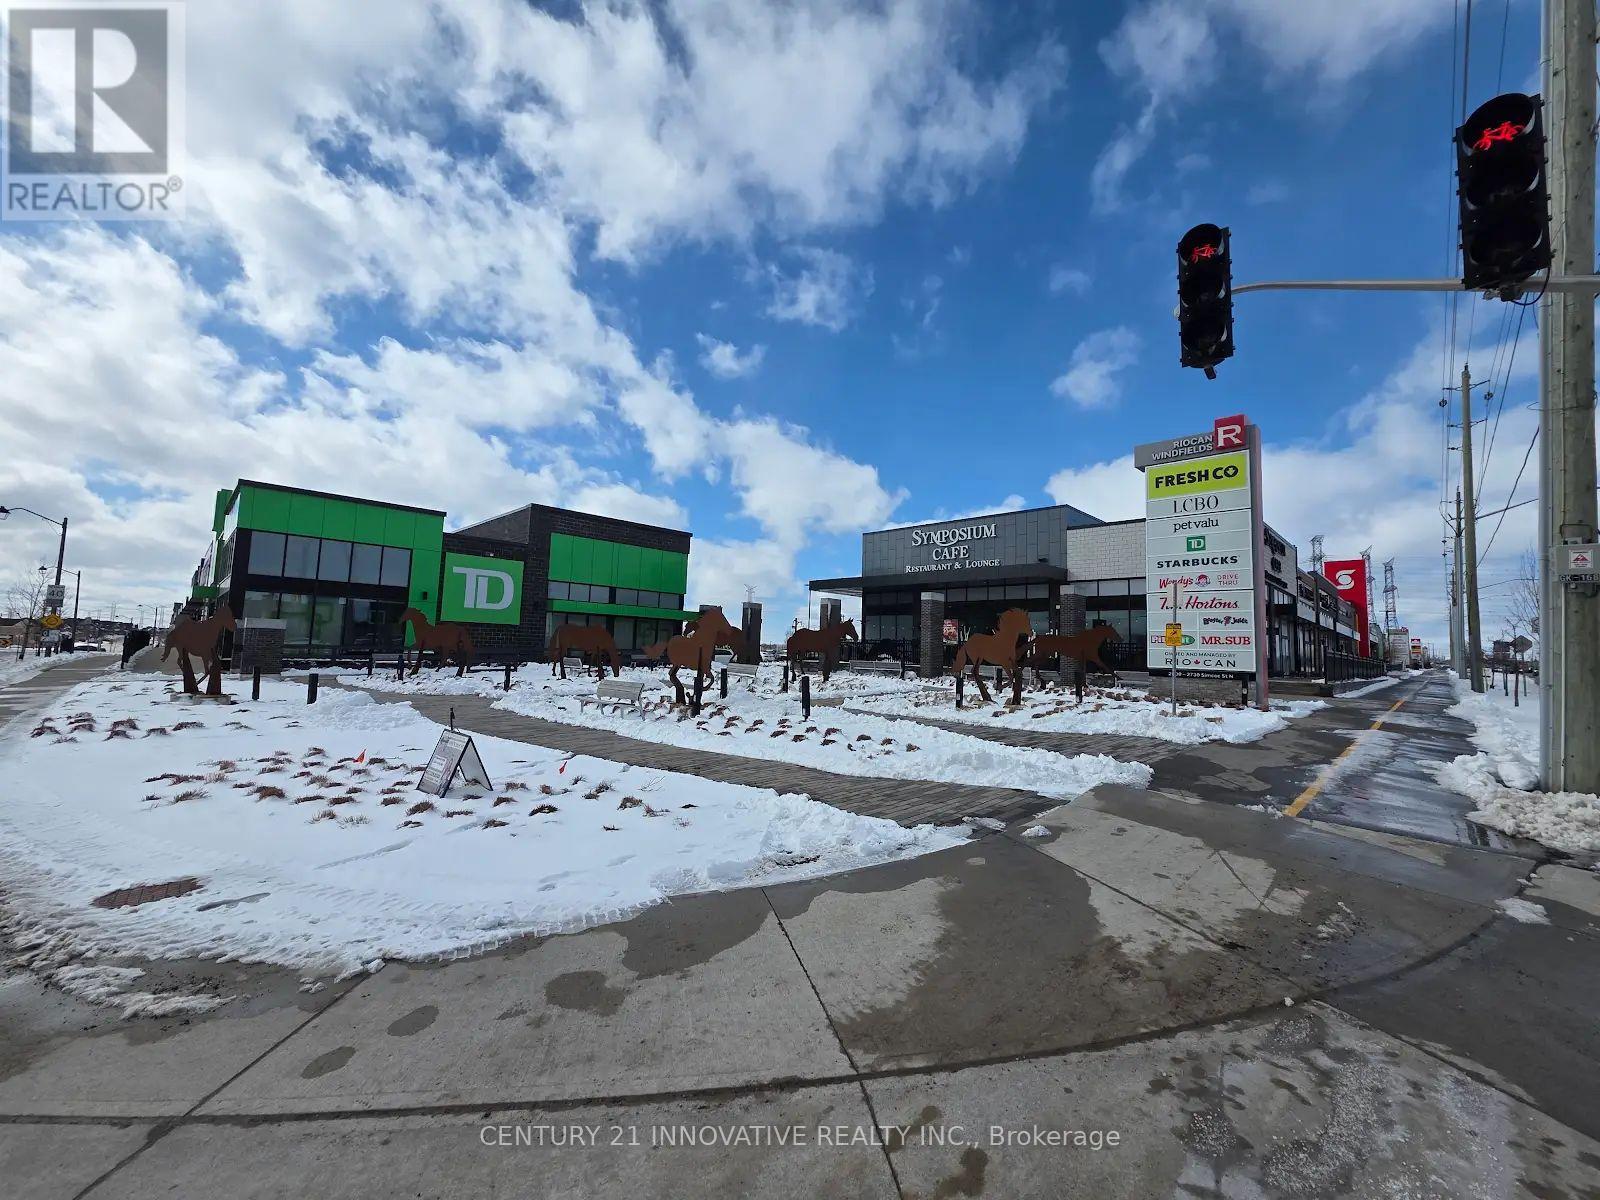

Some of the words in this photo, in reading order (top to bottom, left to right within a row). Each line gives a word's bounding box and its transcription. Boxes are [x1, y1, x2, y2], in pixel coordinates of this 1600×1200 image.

[1173, 434, 1213, 449] RIOCAN
[1217, 425, 1242, 447] R
[1151, 443, 1213, 461] WINDFIELDS
[1173, 495, 1219, 513] LCBO
[1188, 538, 1205, 550] TD
[932, 545, 969, 561] CAFE
[954, 561, 962, 569] &
[1157, 555, 1238, 568] STARBUCKS
[452, 566, 514, 610] TD
[1185, 595, 1239, 610] Hortons
